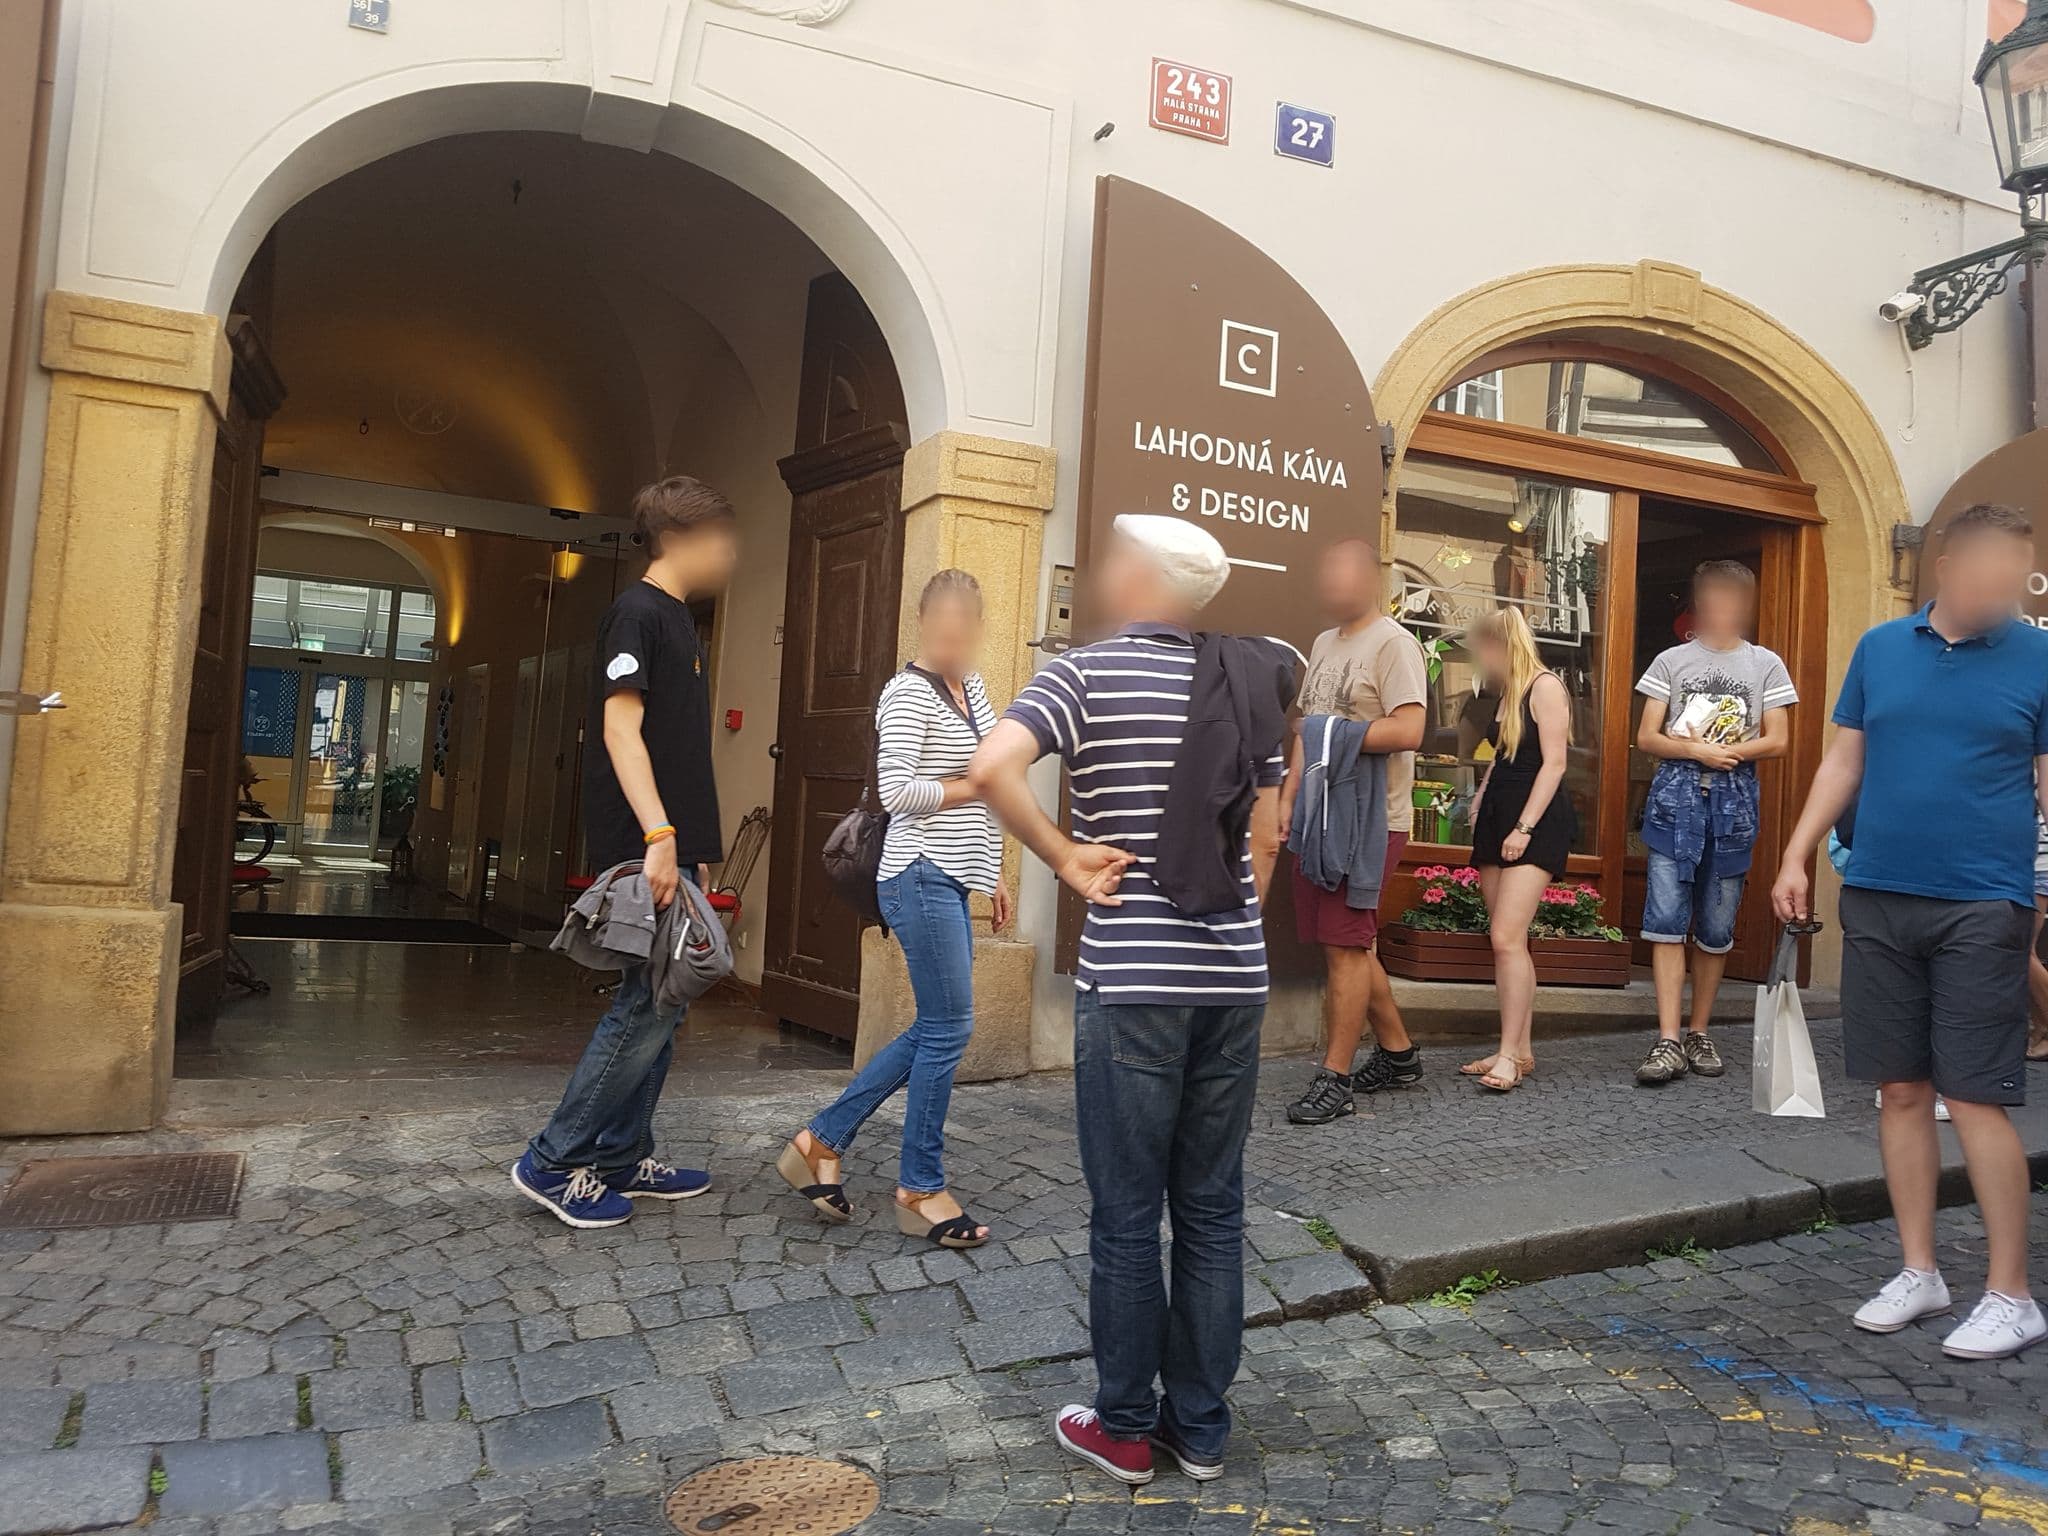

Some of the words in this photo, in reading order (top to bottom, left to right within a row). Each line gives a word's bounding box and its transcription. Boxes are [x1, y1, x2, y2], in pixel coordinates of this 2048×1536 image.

[364, 12, 379, 24] 39
[1166, 68, 1221, 106] 243
[1163, 97, 1186, 111] MALÁ
[1187, 103, 1220, 120] STRANA
[1173, 112, 1201, 129] PRAHA
[1205, 121, 1211, 130] 1
[1291, 118, 1325, 149] 27
[1237, 343, 1261, 375] C
[1134, 421, 1274, 475] LAHODNÁ
[1283, 447, 1348, 489] KÁVA
[1171, 483, 1191, 512] &
[1200, 487, 1310, 533] DESIGN
